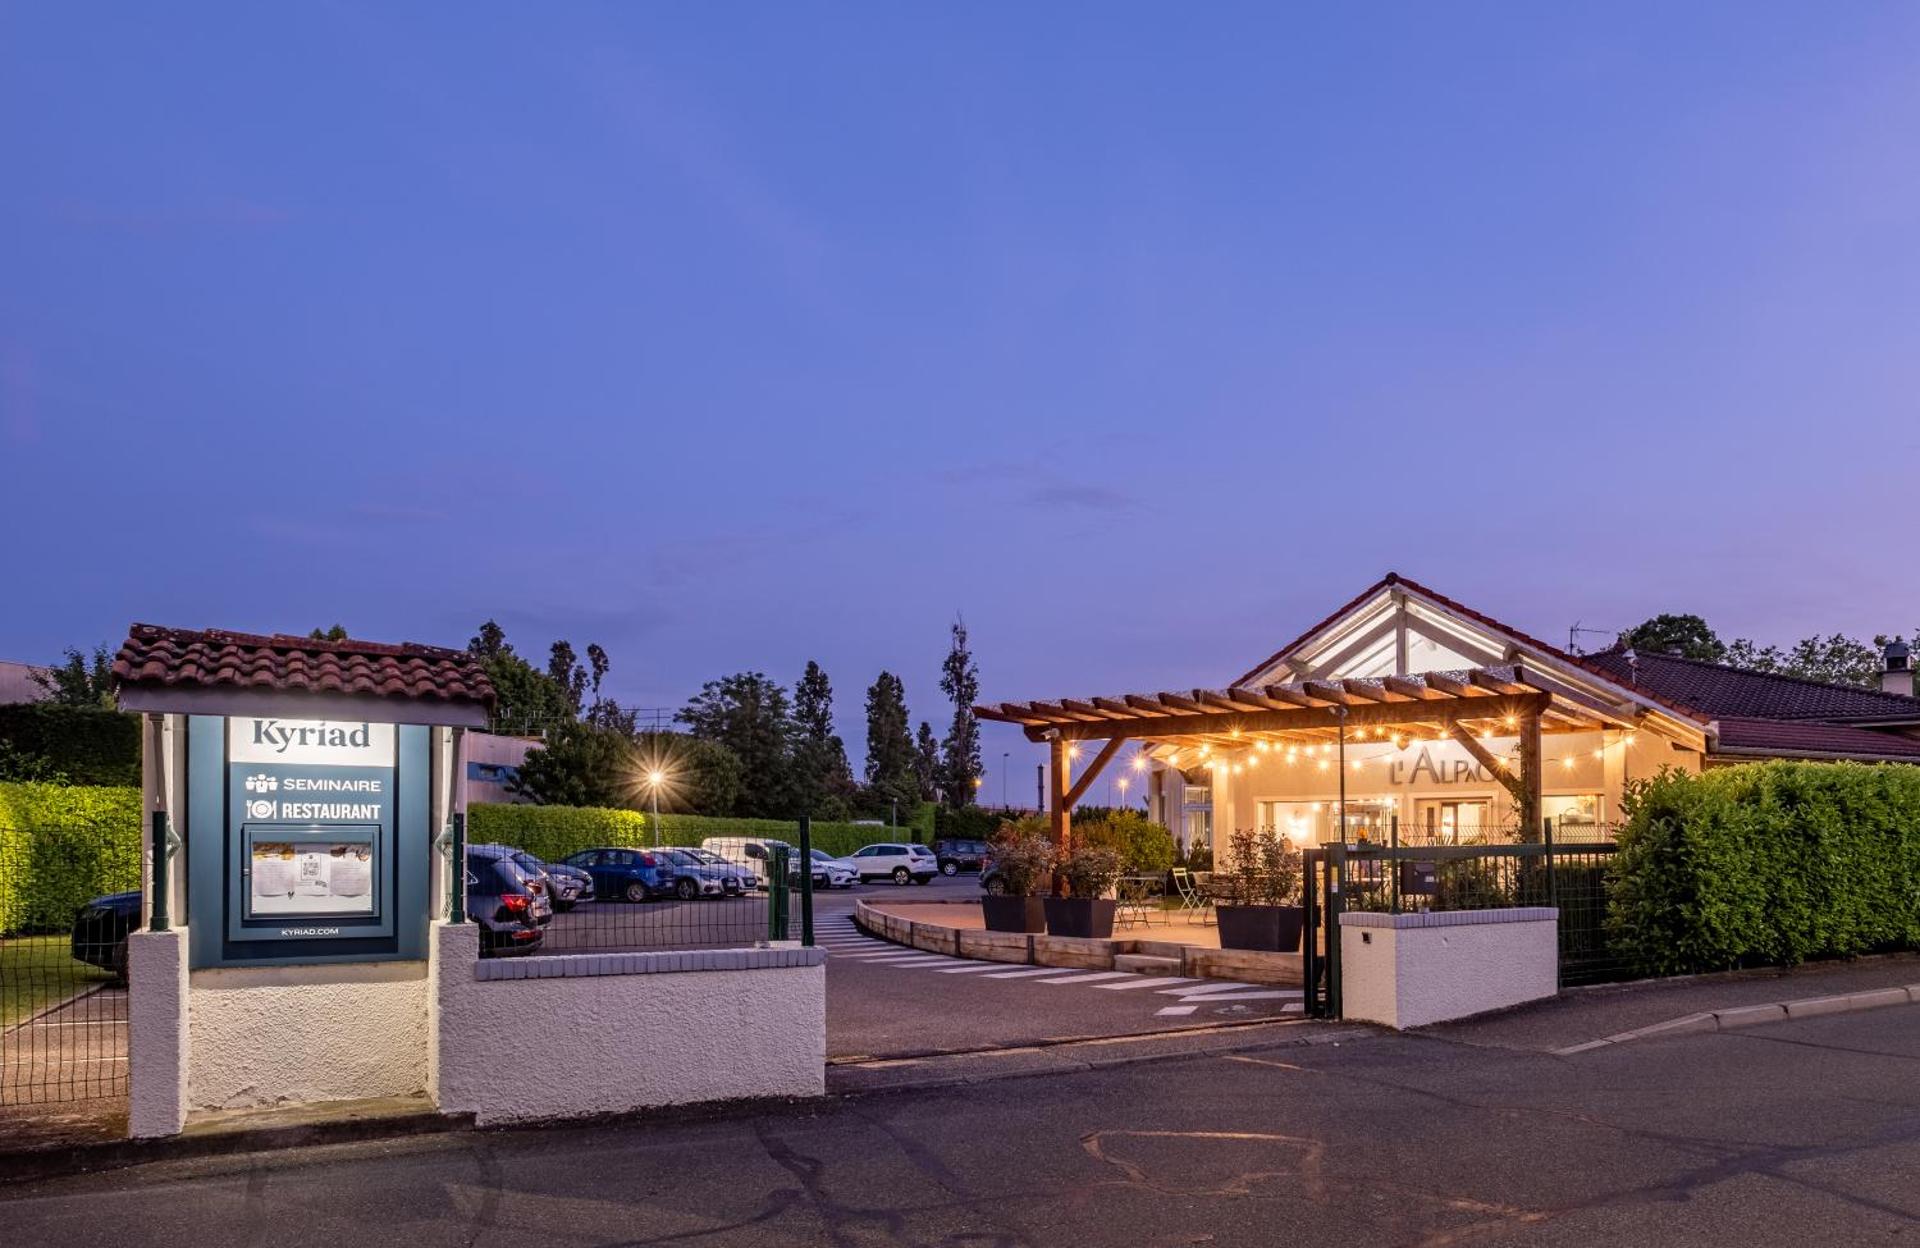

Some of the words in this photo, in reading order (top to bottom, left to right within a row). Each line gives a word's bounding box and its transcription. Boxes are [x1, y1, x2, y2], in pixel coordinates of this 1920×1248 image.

[253, 720, 371, 753] Kyriad
[283, 778, 382, 792] SEMINAIRE
[282, 802, 381, 819] RESTAURANT
[281, 928, 339, 936] KYRIAD.COM
